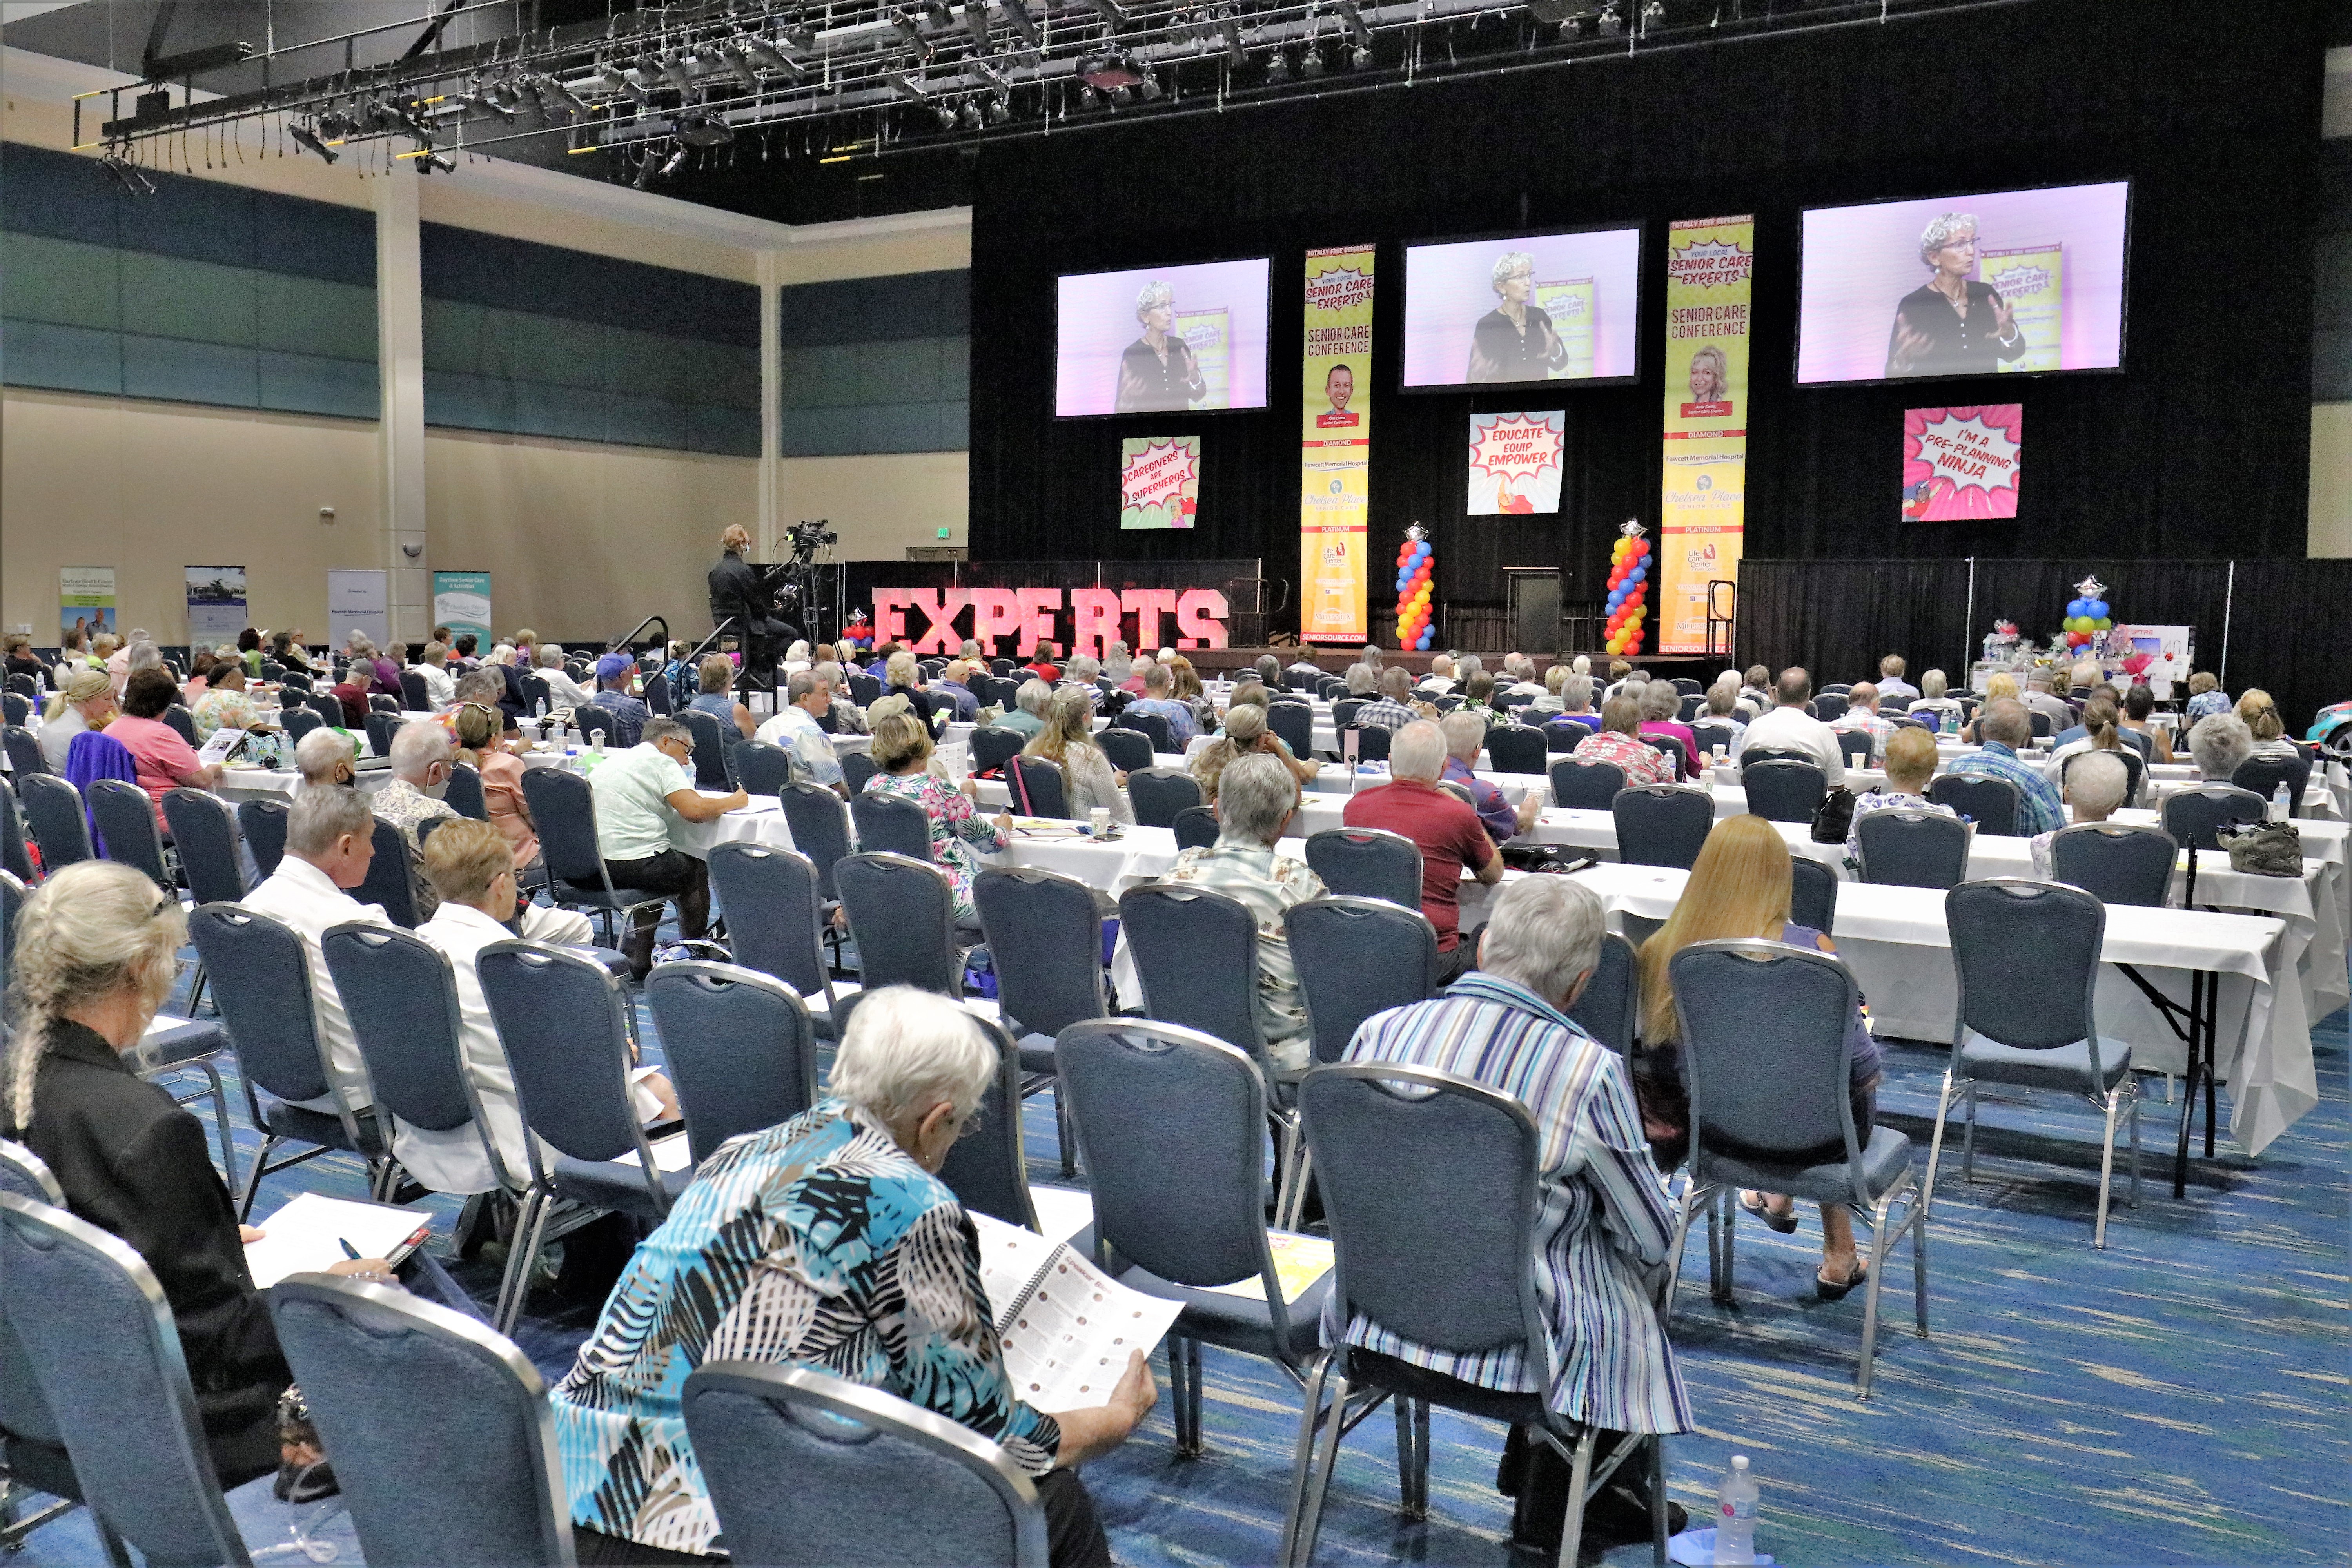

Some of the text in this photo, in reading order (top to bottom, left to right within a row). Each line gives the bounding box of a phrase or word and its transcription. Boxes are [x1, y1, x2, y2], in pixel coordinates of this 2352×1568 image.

[1671, 255, 1753, 271] SENIOR CARE
[1682, 270, 1740, 284] EXPERTS
[1306, 278, 1372, 299] SENIOR CARE
[1317, 292, 1363, 310] EXPERTS
[1672, 304, 1747, 323] SENIOR CARE
[1308, 325, 1369, 342] SENIOR CARE
[1672, 321, 1746, 339] CONFERENCE
[1308, 340, 1369, 356] CONFERENCE
[1493, 428, 1544, 441] EDUCATE
[1957, 429, 1989, 447] I'M A
[1504, 442, 1532, 453] EQUIP
[1925, 434, 2011, 469] PRE-PLANNING
[1128, 451, 1178, 481] CAREGIVERS
[1488, 452, 1547, 466] EMPOWER
[1937, 452, 1987, 479] NINJA
[1150, 470, 1161, 481] ARE
[1132, 470, 1185, 501] SUPERHEROS
[1305, 494, 1366, 505] Chelsea Place
[1666, 490, 1742, 503] Chelsea Place
[872, 587, 1229, 659] EXPERTS
[1065, 1256, 1095, 1281] Speaker
